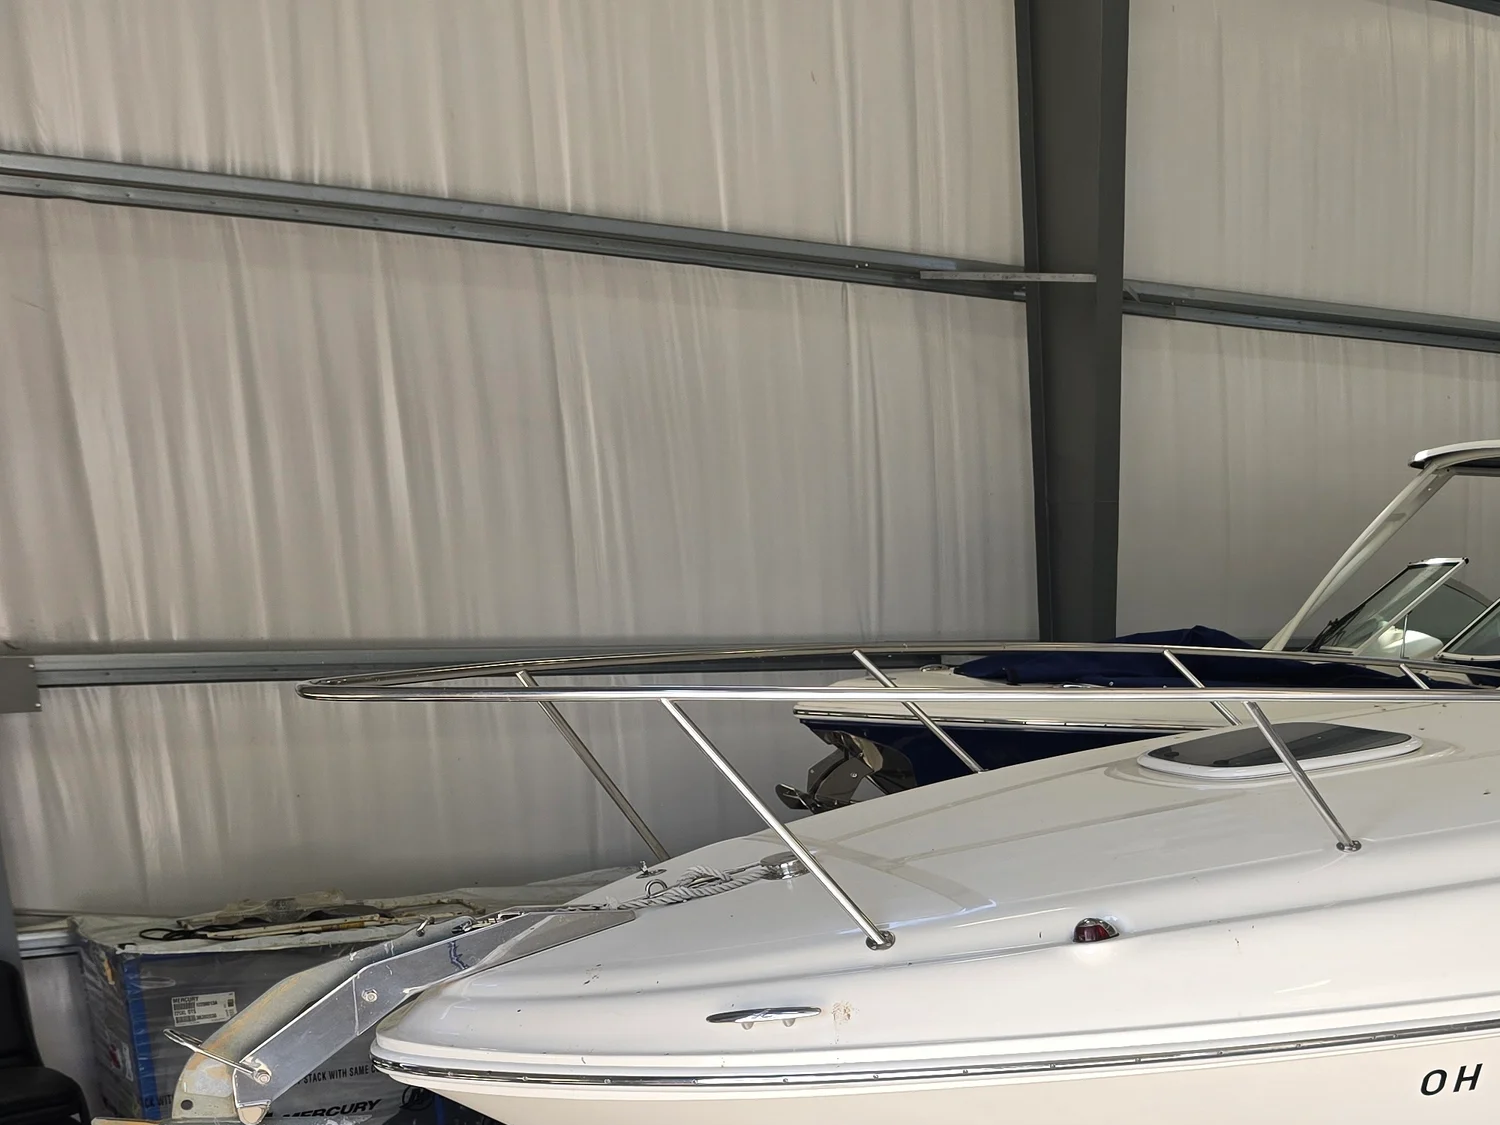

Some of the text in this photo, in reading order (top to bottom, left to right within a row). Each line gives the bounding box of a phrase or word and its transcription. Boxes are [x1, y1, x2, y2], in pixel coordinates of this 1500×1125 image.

[303, 1071, 326, 1085] STACK
[328, 1067, 347, 1080] WITH
[349, 1064, 369, 1077] SAME
[1420, 1063, 1483, 1096] OH
